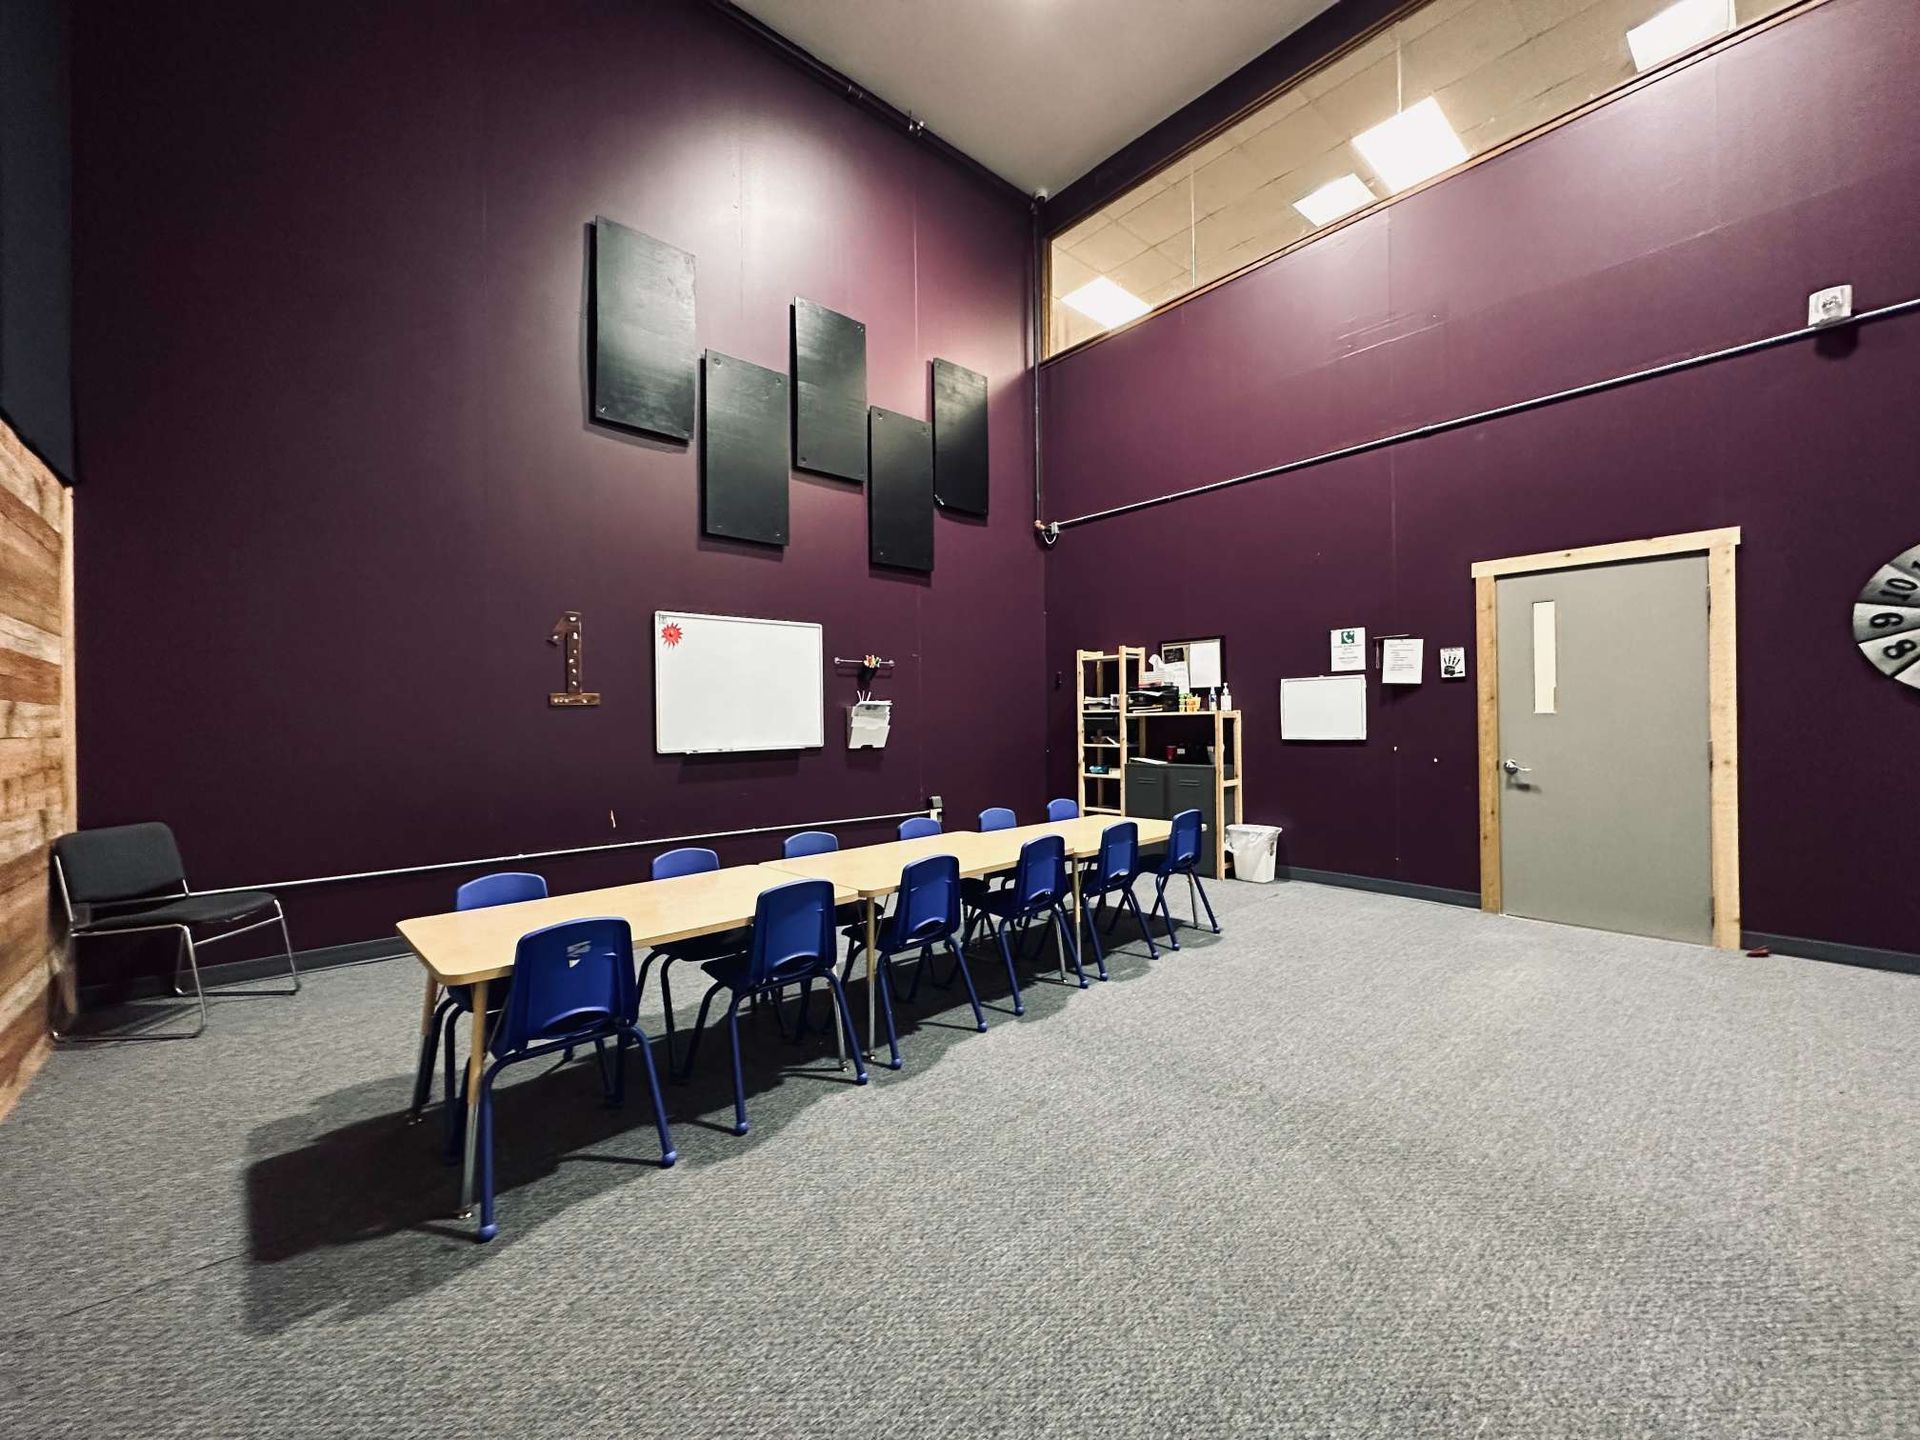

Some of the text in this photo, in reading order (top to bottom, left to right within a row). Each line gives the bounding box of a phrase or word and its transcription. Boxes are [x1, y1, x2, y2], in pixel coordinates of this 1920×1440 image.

[1880, 578, 1918, 601] 10
[1870, 612, 1904, 628] 9
[547, 611, 600, 705] 1
[1883, 639, 1917, 659] 8
